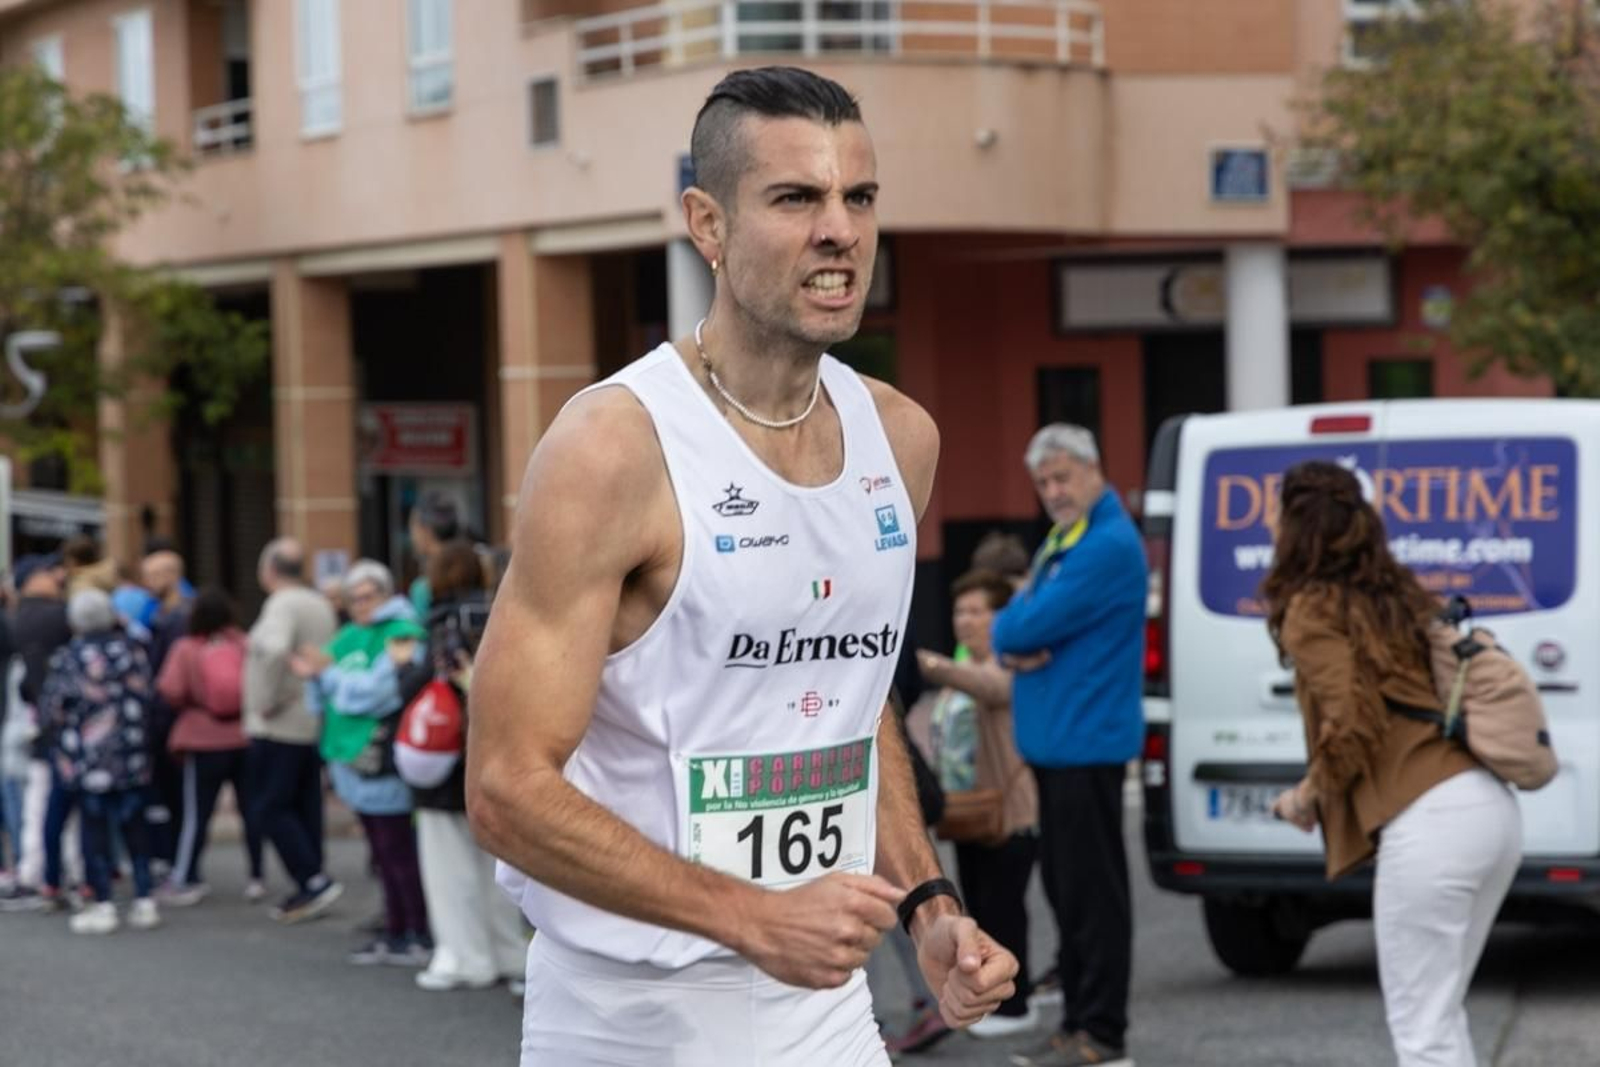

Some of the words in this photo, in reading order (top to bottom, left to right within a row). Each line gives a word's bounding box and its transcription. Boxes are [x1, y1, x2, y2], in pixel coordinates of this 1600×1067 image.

[875, 533, 909, 551] LEVASA
[726, 633, 770, 663] Da
[701, 758, 744, 799] XI
[737, 803, 843, 879] 165
